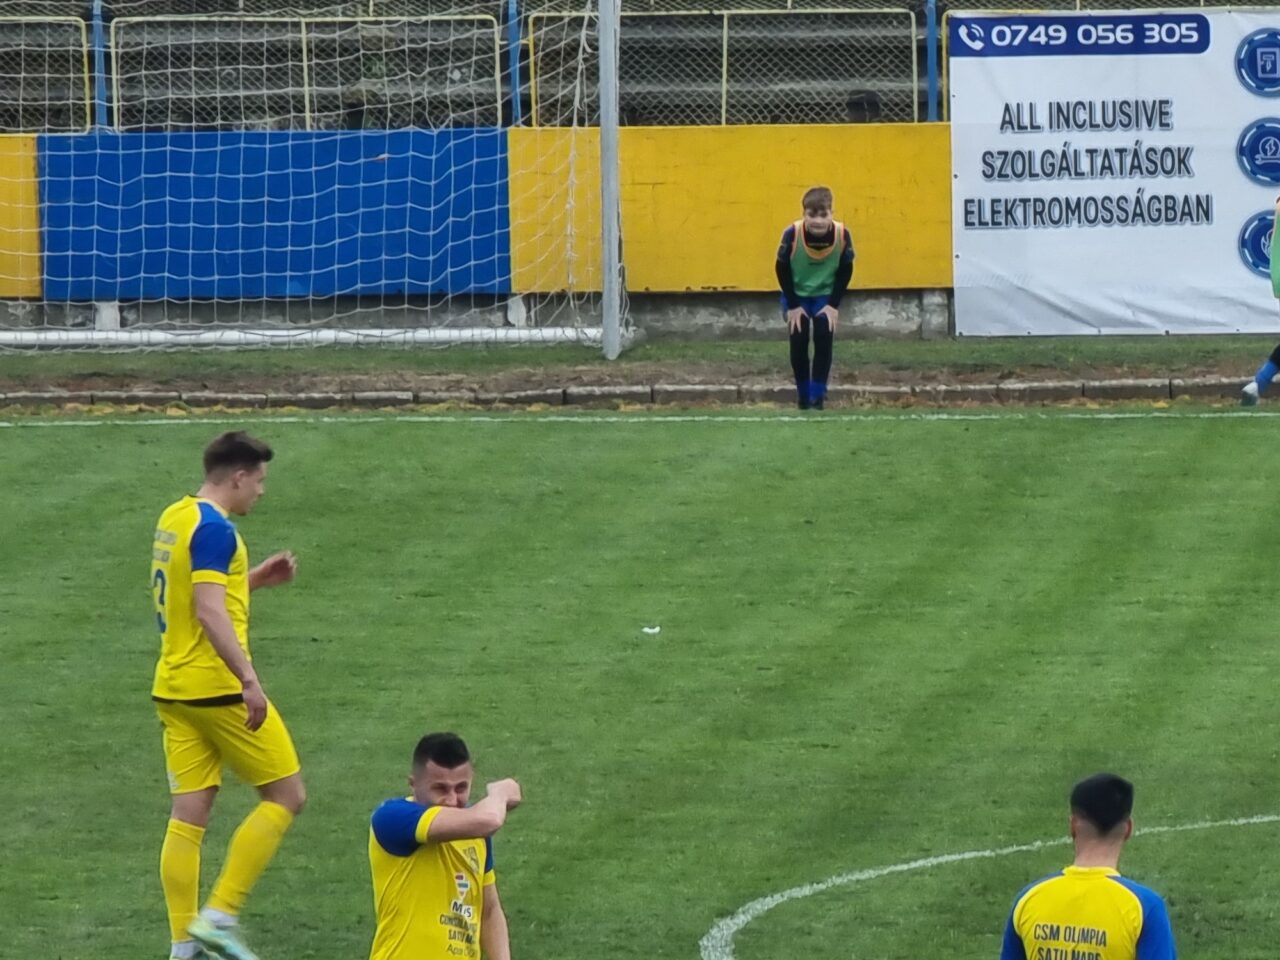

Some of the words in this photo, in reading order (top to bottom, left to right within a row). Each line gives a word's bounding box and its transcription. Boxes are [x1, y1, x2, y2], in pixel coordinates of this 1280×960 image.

[991, 24, 1066, 46] 0749
[1077, 23, 1134, 45] 056
[1144, 22, 1198, 44] 305
[1000, 101, 1041, 132] ALL
[1049, 100, 1173, 131] INCLUSIVE
[981, 140, 1194, 180] SZOLGÁLTATÁSOK
[963, 188, 1212, 228] ELEKTROMOSSÁGBAN
[1034, 924, 1060, 941] CSM
[1064, 926, 1107, 948] OLIMPIA
